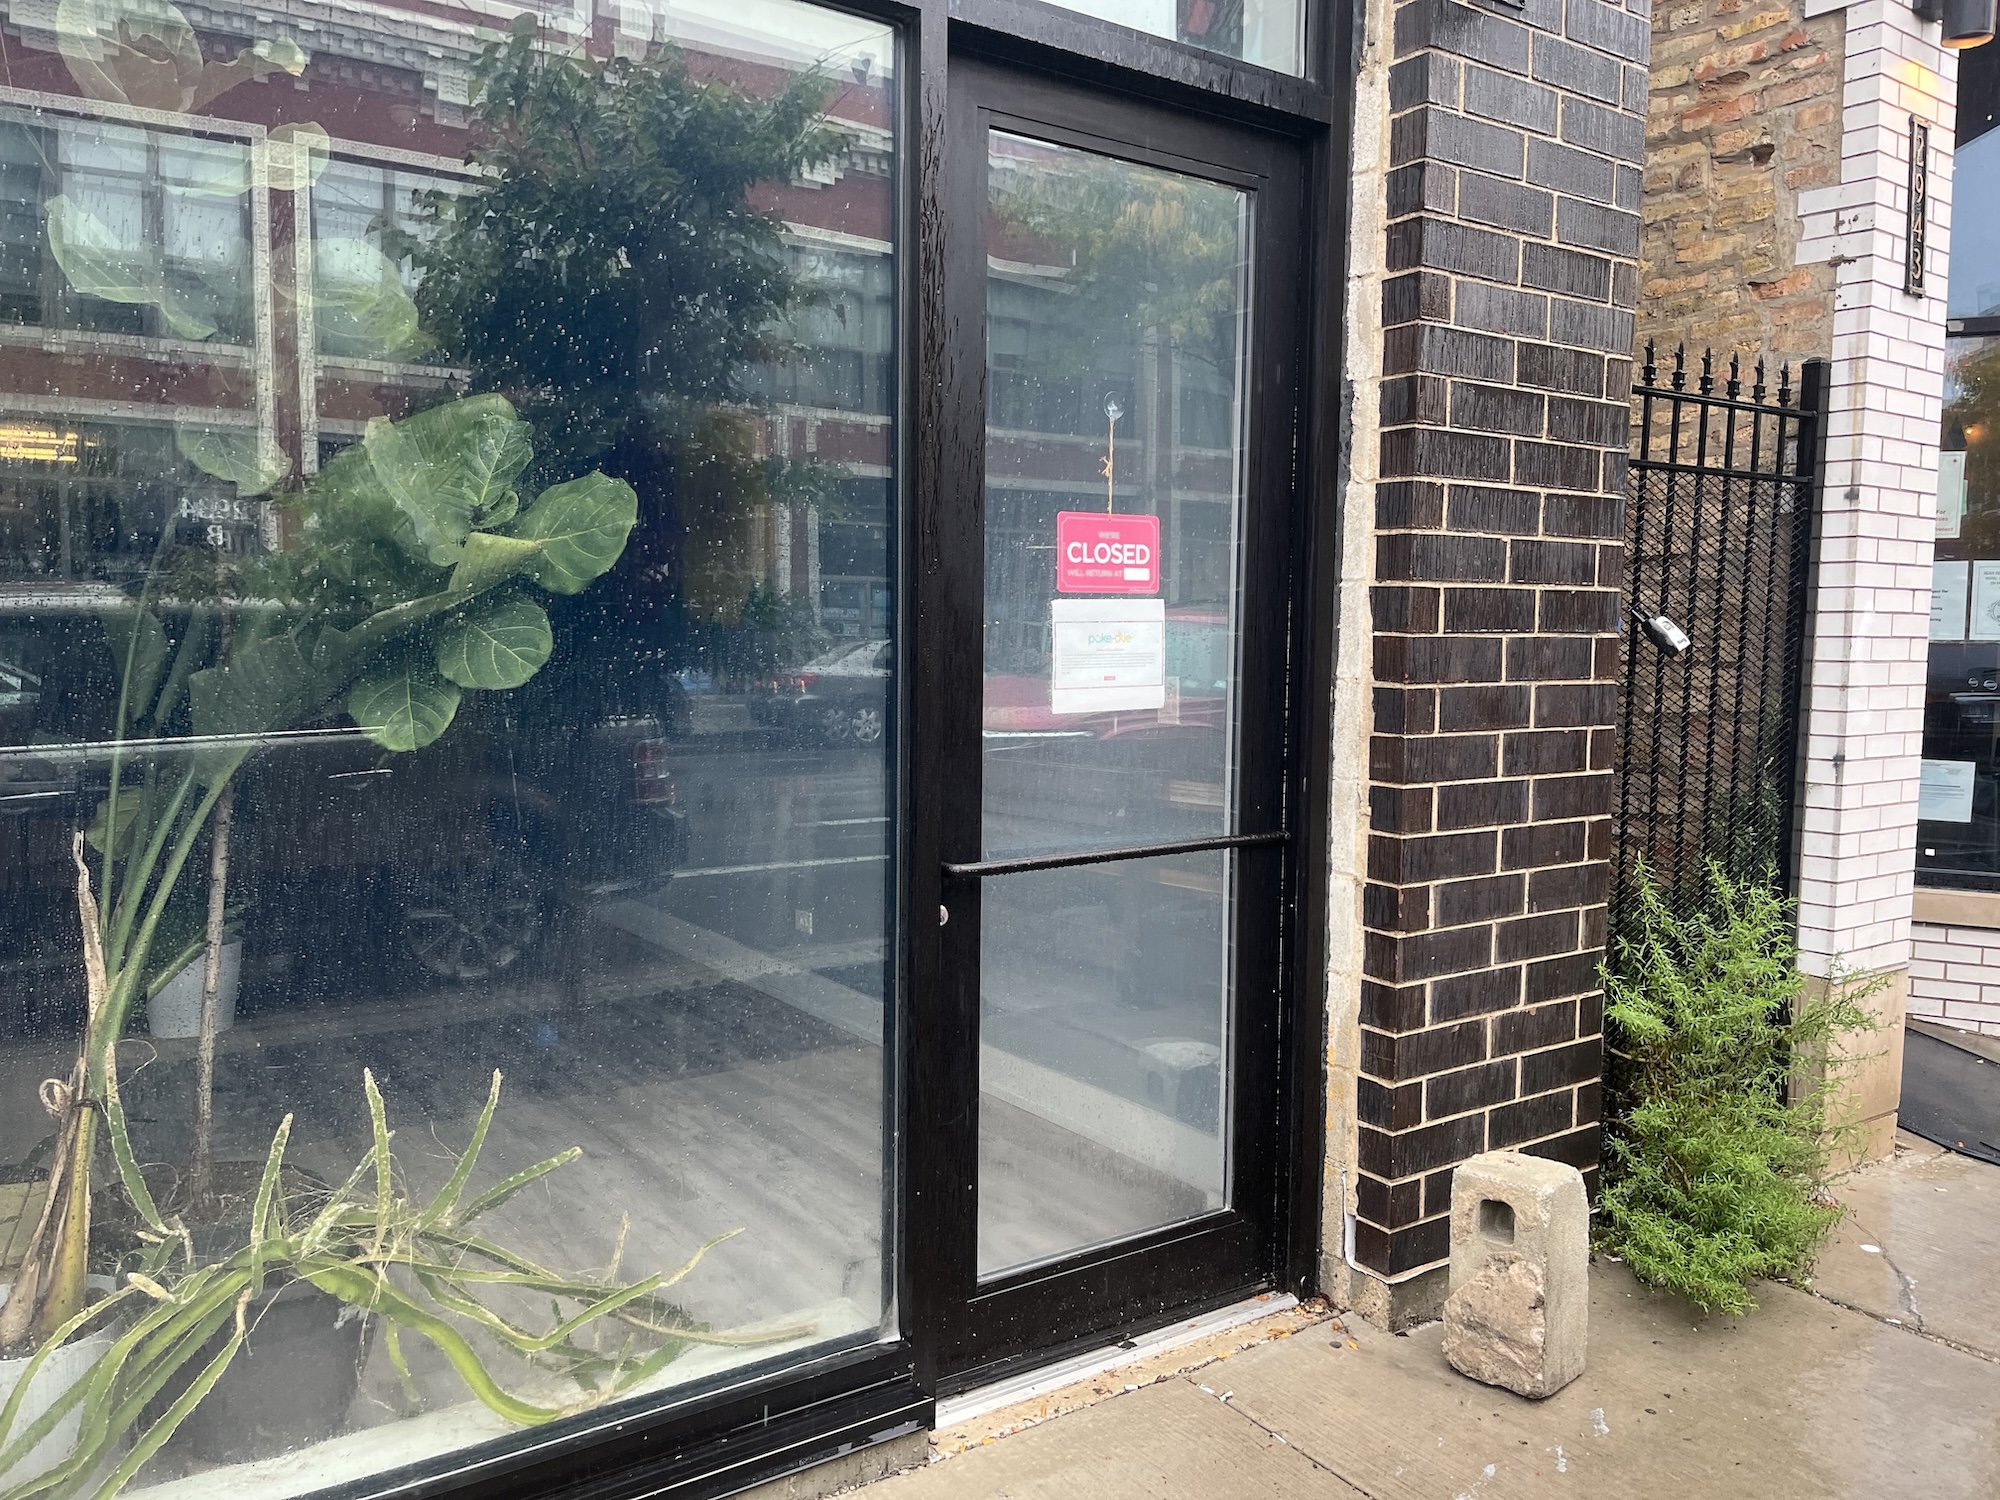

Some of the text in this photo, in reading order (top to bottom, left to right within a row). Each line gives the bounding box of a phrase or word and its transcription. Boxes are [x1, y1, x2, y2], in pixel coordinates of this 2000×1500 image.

[1912, 136, 1924, 280] 2943
[1067, 541, 1150, 564] CLOSED
[1067, 569, 1084, 577] WILL
[1086, 569, 1112, 577] RETURN
